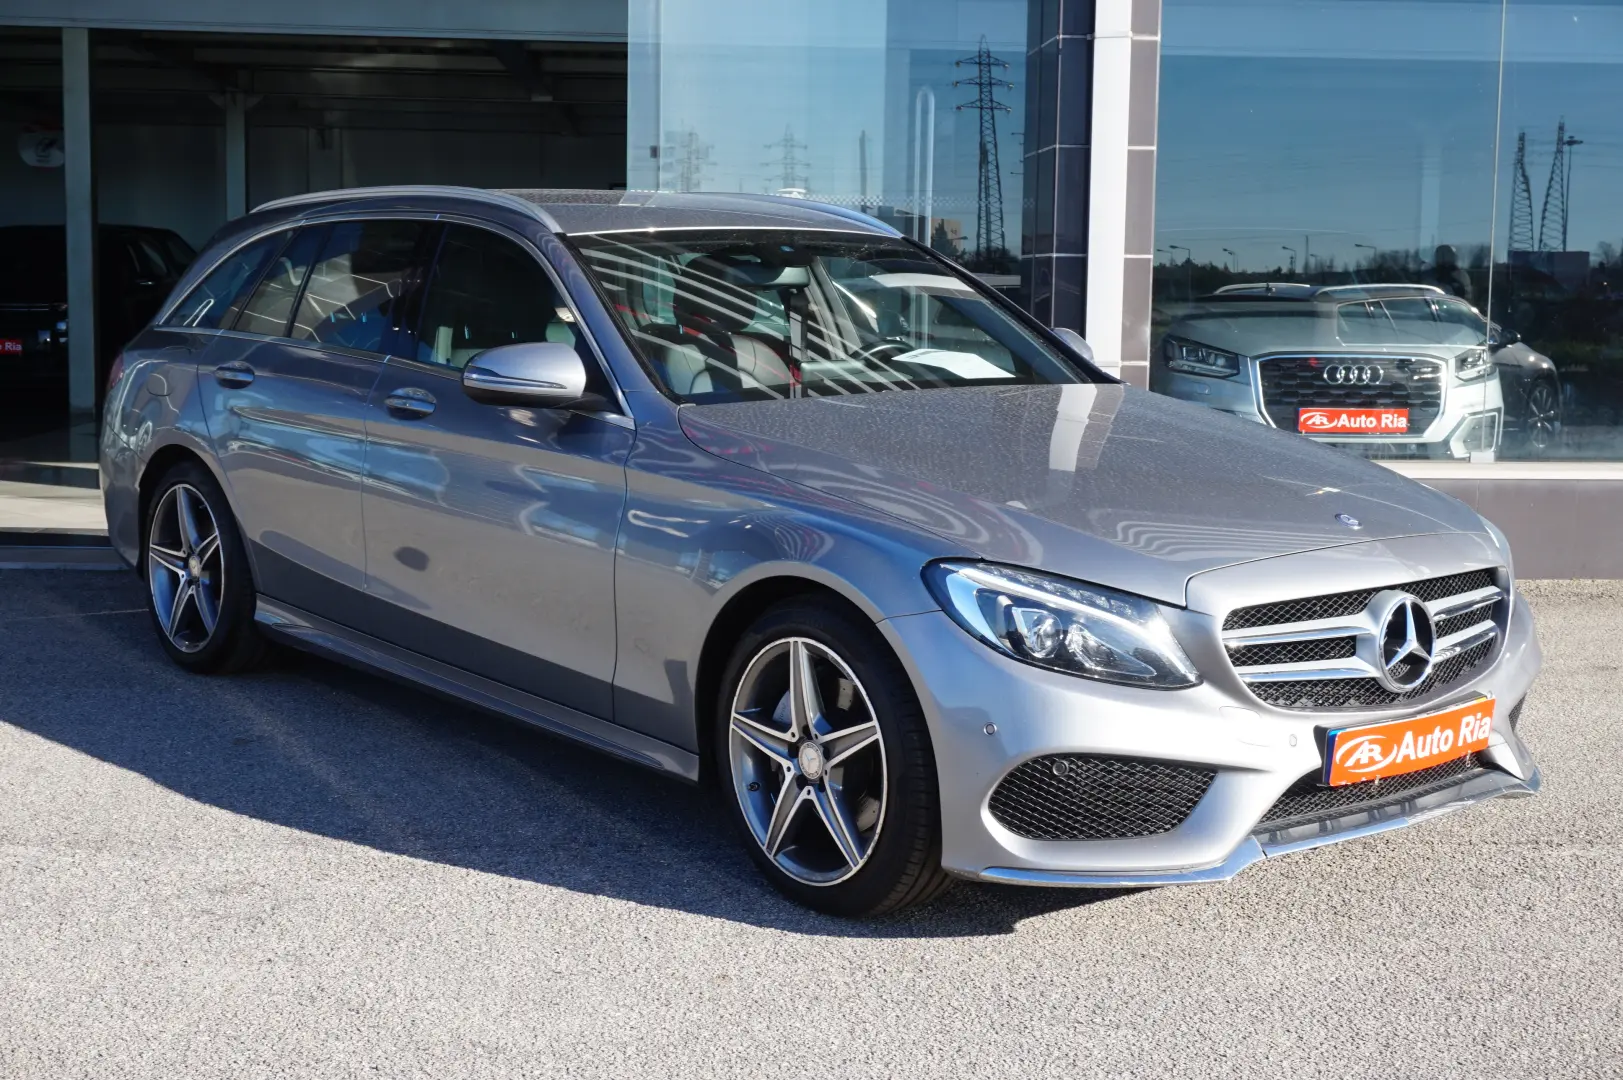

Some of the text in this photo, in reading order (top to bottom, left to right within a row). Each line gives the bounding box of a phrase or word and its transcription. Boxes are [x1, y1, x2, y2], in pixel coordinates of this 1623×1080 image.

[4, 341, 23, 351] Ria
[1336, 413, 1377, 428] Auto
[1381, 413, 1407, 428] Ria
[1395, 726, 1454, 763] Auto
[1457, 712, 1492, 747] Ria
